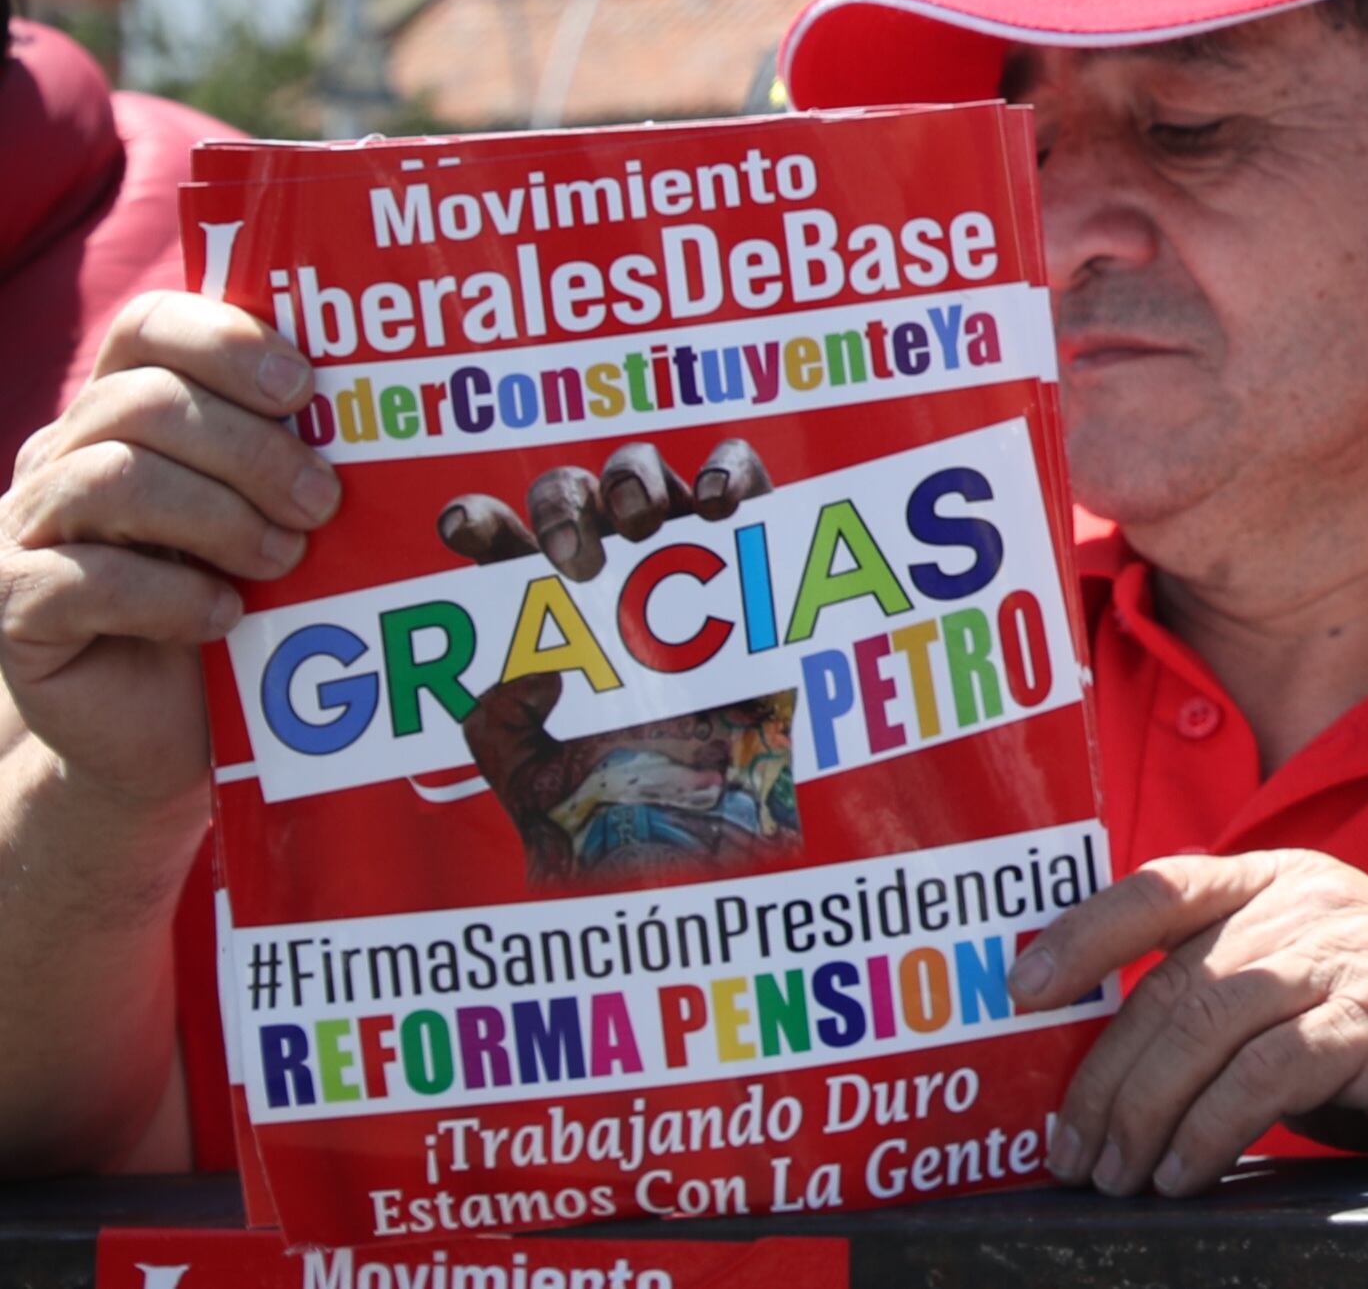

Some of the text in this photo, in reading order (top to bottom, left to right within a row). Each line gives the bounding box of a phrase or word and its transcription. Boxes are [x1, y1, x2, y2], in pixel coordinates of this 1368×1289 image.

[369, 148, 817, 248] Movimiento
[298, 304, 1001, 449] oderConstituyenteYa
[259, 466, 1005, 757] GRACIAS
[800, 589, 1053, 772] PETRO
[246, 835, 1097, 1011] #FirmaSanciónPresidencial
[260, 928, 1103, 1109] REFORMA PENSION
[370, 1183, 616, 1237] Estamos
[635, 1169, 748, 1218] Con
[768, 1155, 841, 1214] La
[424, 1066, 979, 1183] ¡Trabajando Duro
